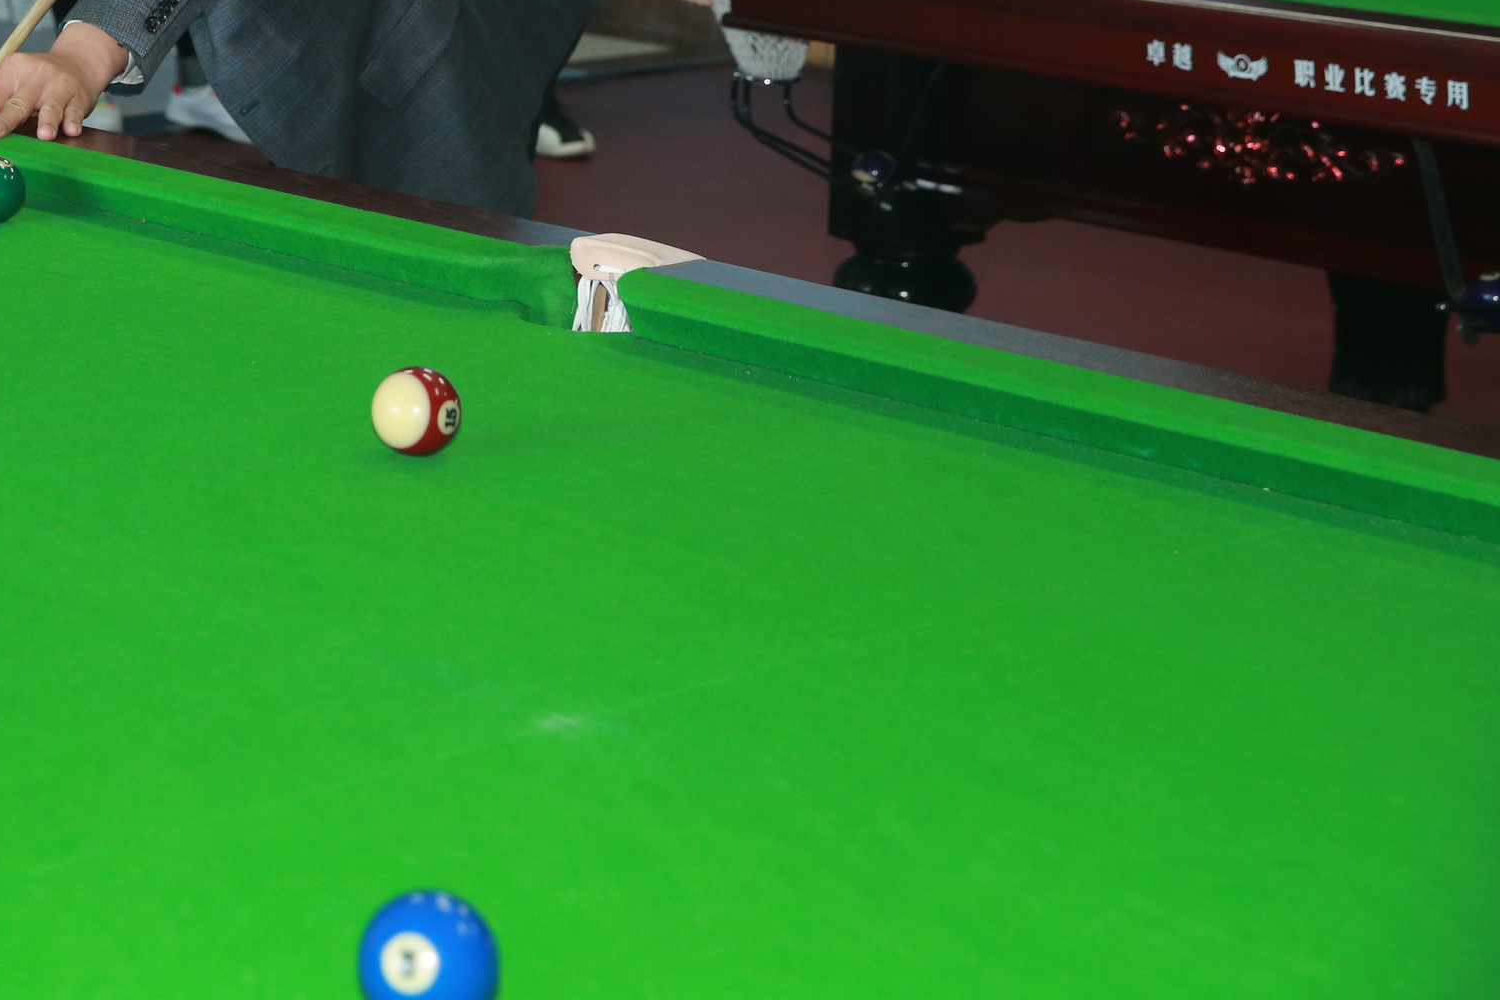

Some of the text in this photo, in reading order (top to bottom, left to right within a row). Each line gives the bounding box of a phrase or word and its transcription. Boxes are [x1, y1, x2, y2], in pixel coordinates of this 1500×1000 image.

[1146, 39, 1470, 111] 卓越 职业比赛专用
[445, 408, 458, 428] 15
